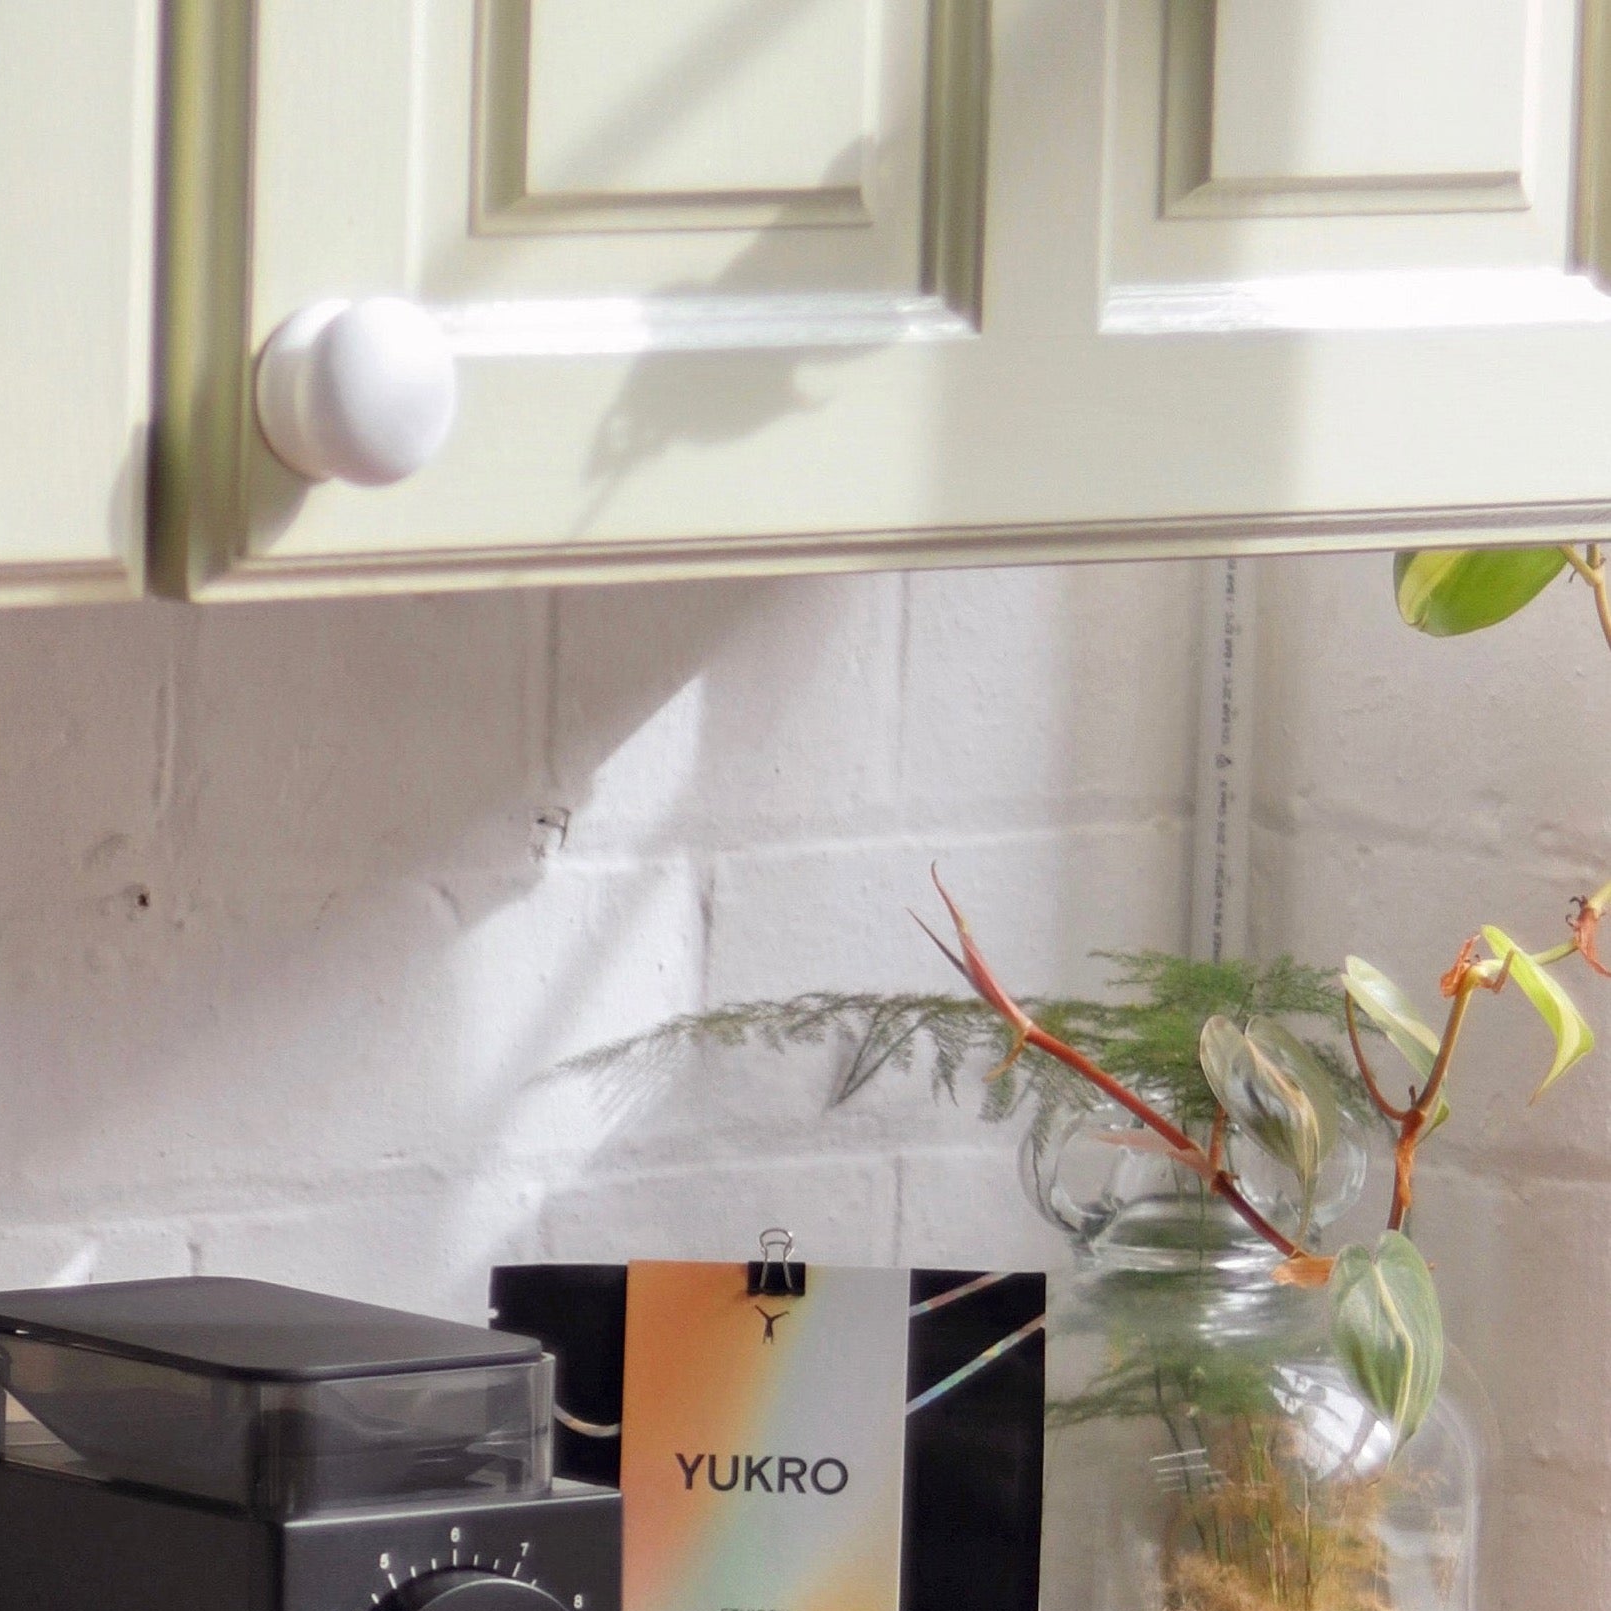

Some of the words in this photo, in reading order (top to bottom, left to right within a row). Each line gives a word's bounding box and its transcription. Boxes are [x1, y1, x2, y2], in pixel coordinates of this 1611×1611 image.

[675, 1452, 849, 1495] YUKRO
[450, 1527, 460, 1542] 6
[520, 1542, 530, 1557] 7
[379, 1553, 389, 1569] 5
[573, 1594, 583, 1609] 8
